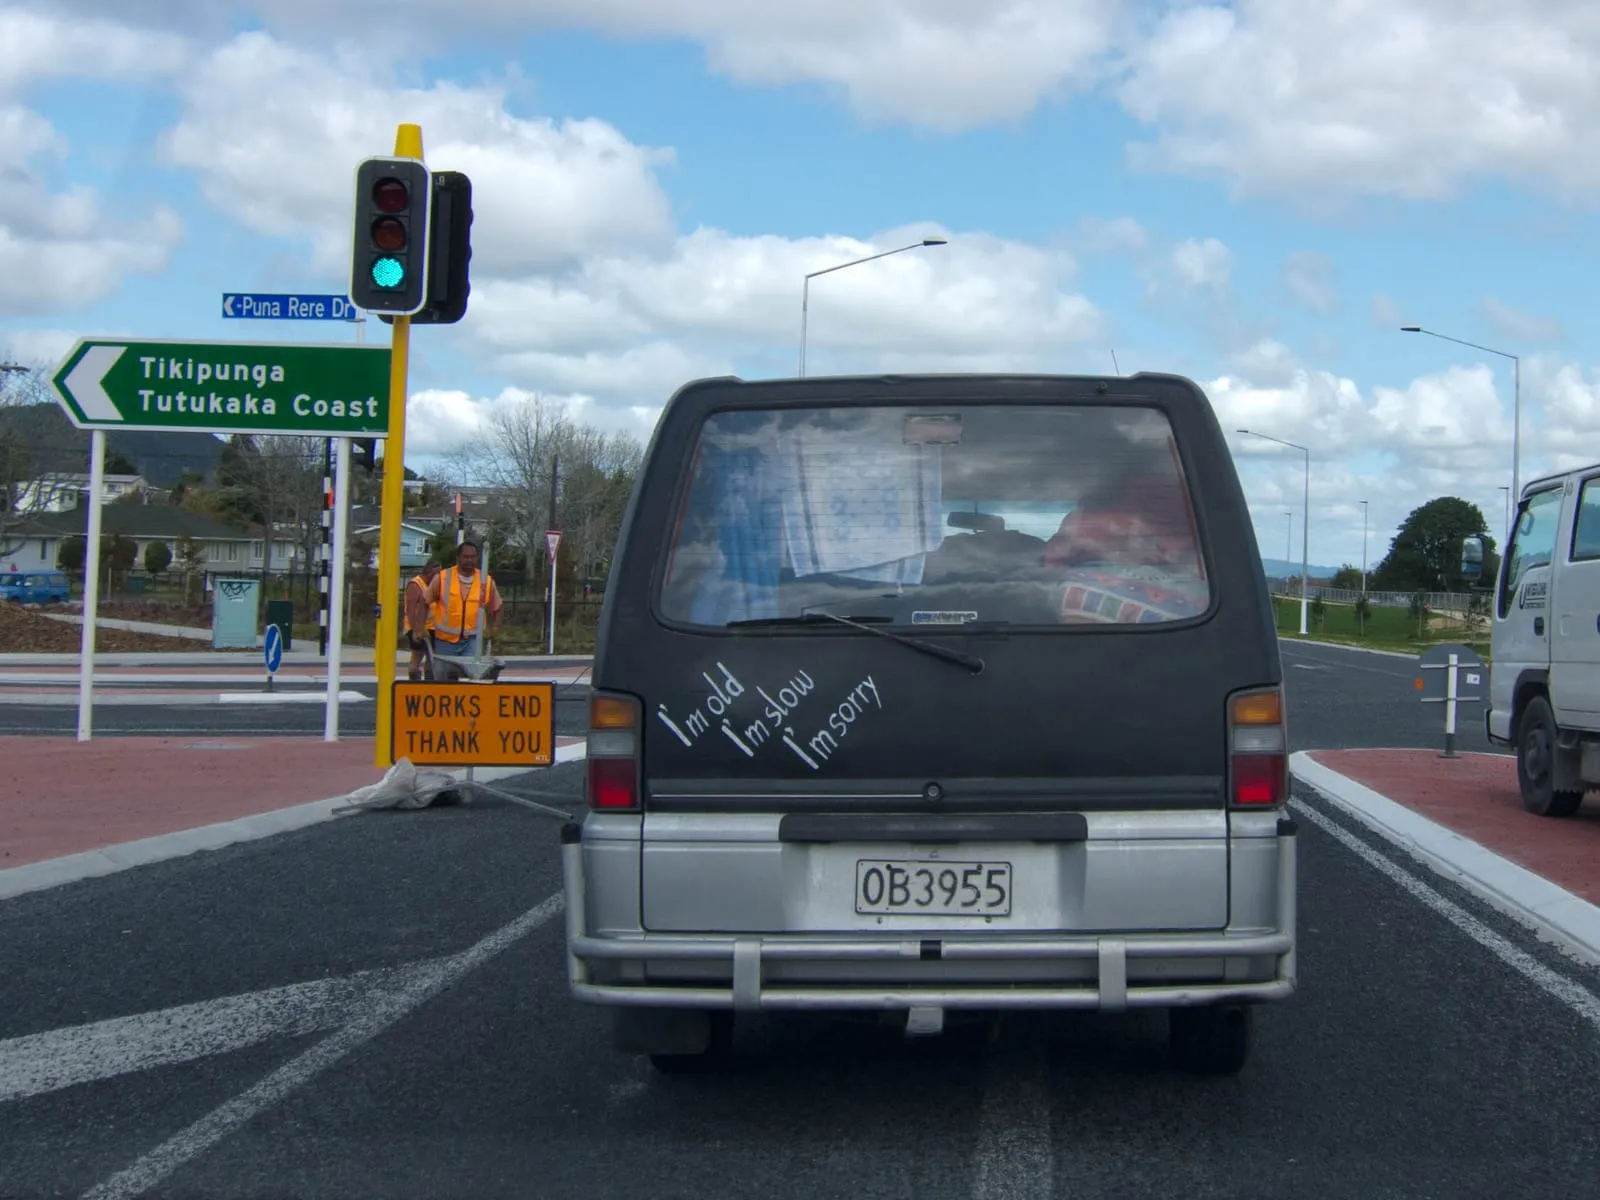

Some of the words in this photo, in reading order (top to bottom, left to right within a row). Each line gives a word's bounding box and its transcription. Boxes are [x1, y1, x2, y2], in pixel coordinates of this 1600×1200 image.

[242, 296, 280, 317] Puna
[288, 297, 325, 317] Rere
[332, 298, 350, 318] Dr
[140, 356, 285, 388] Tikipunga
[138, 389, 277, 415] Tutukaka
[293, 393, 378, 418] Coast
[405, 695, 481, 719] WORKS
[498, 695, 542, 719] END
[658, 703, 710, 747] I'm
[702, 662, 745, 716] old
[721, 718, 770, 758] I'm
[756, 669, 815, 728] slow
[782, 726, 839, 770] I'm
[829, 675, 882, 737] sorry
[405, 731, 480, 753] THANK
[498, 731, 541, 754] YOU
